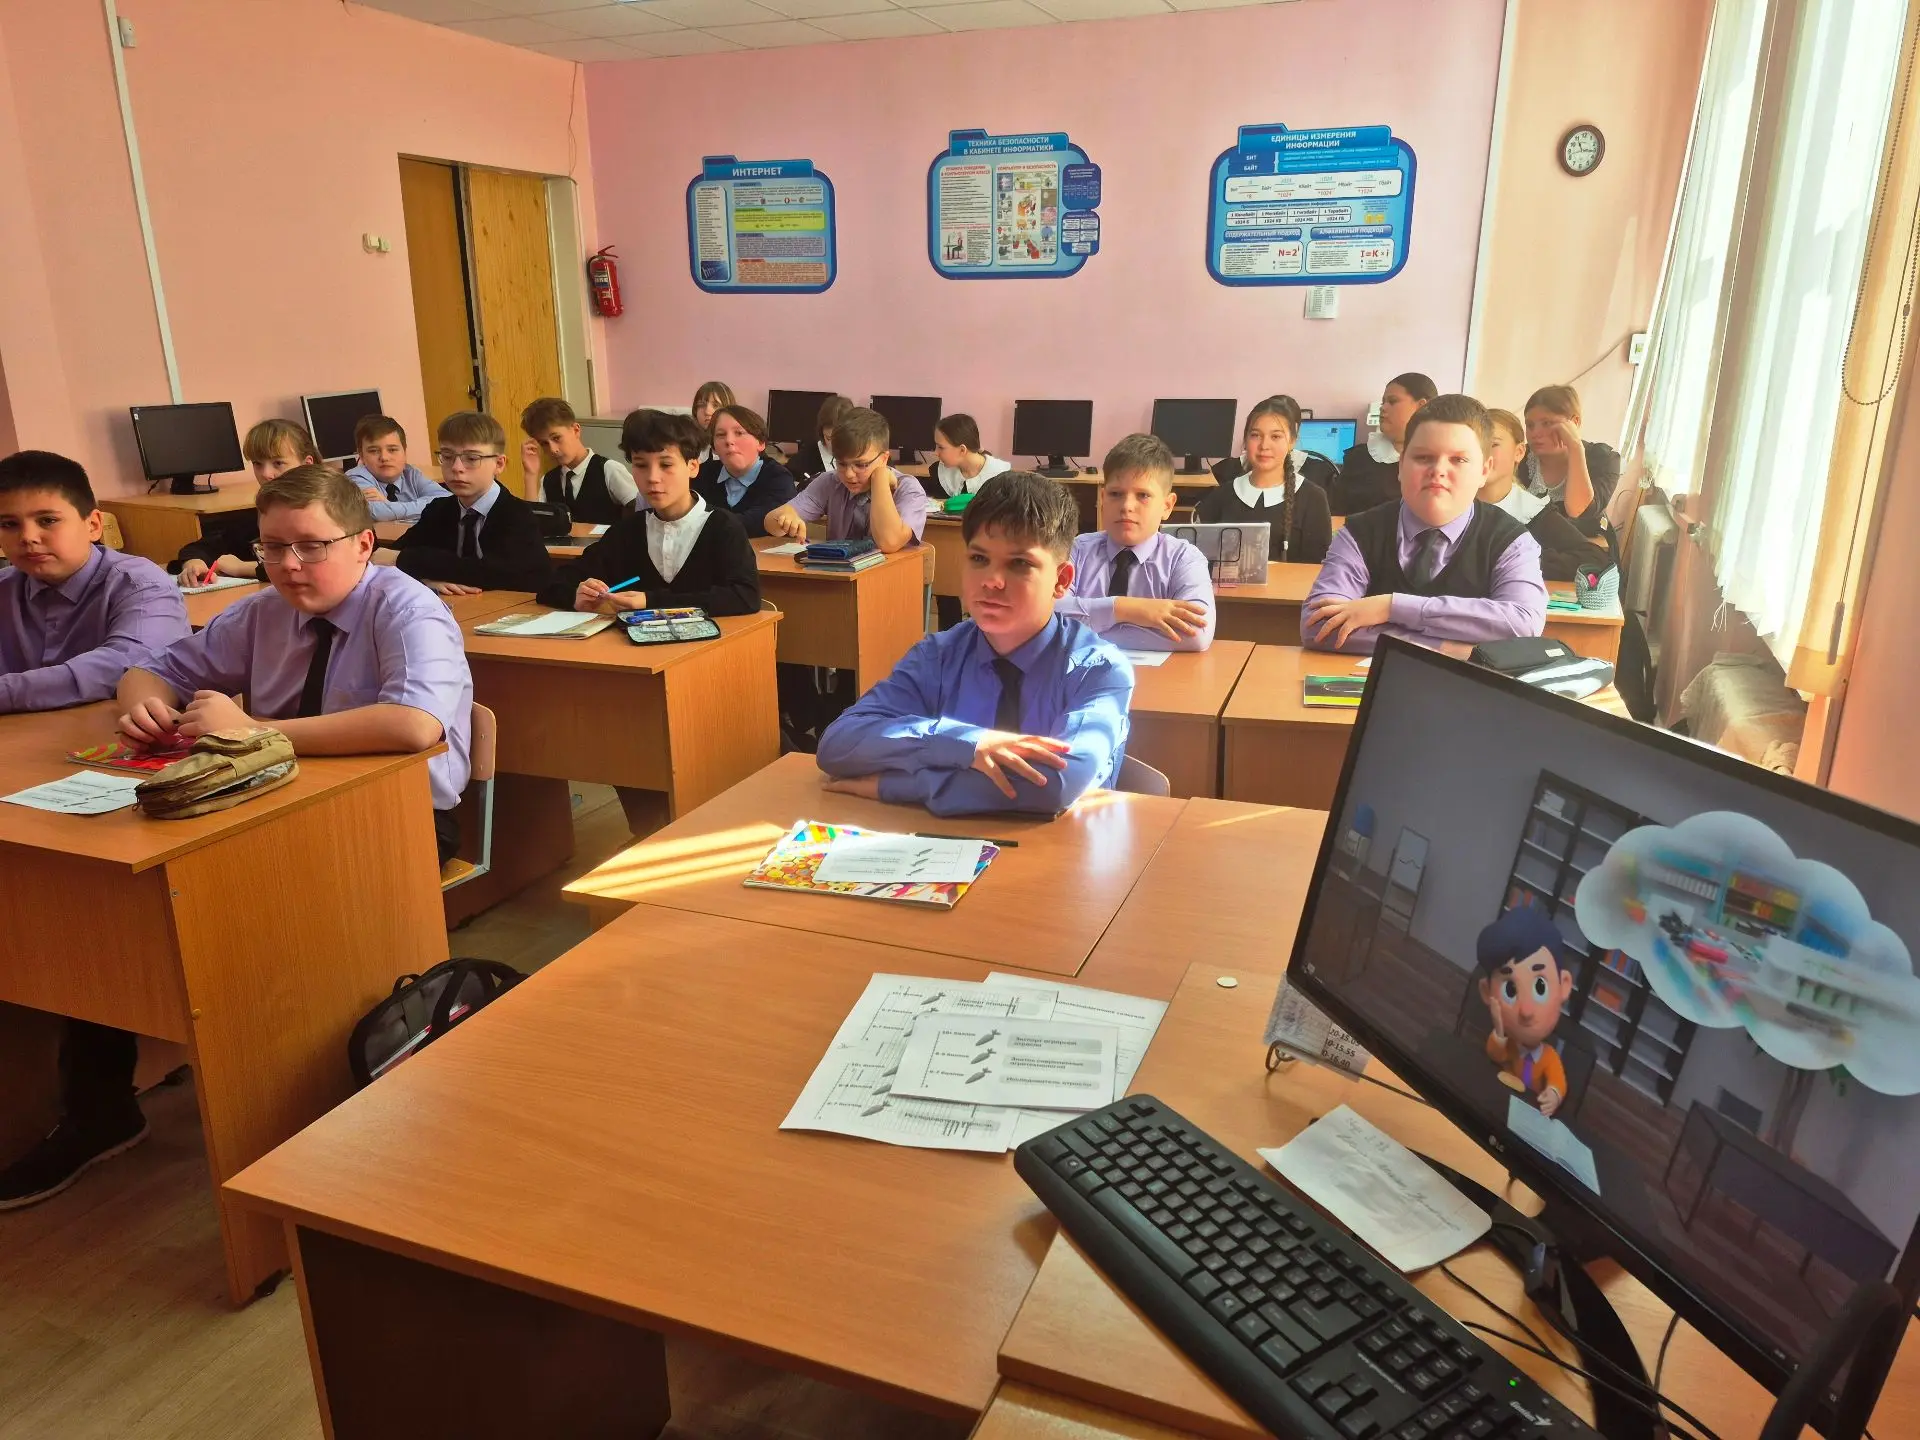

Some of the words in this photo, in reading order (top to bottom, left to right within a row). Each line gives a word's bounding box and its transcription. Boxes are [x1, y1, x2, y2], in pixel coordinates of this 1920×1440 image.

[998, 137, 1049, 145] БЕЗОПАСНОСТИ
[1271, 134, 1309, 143] ЕДИНИЦЫ
[1311, 131, 1356, 140] ИЗМЕРЕНИЯ
[1003, 144, 1054, 153] ИНФОРМАТИКИ
[1286, 140, 1340, 149] ИНФОРМАЦИИ
[732, 167, 782, 177] ИНТЕРНЕТ
